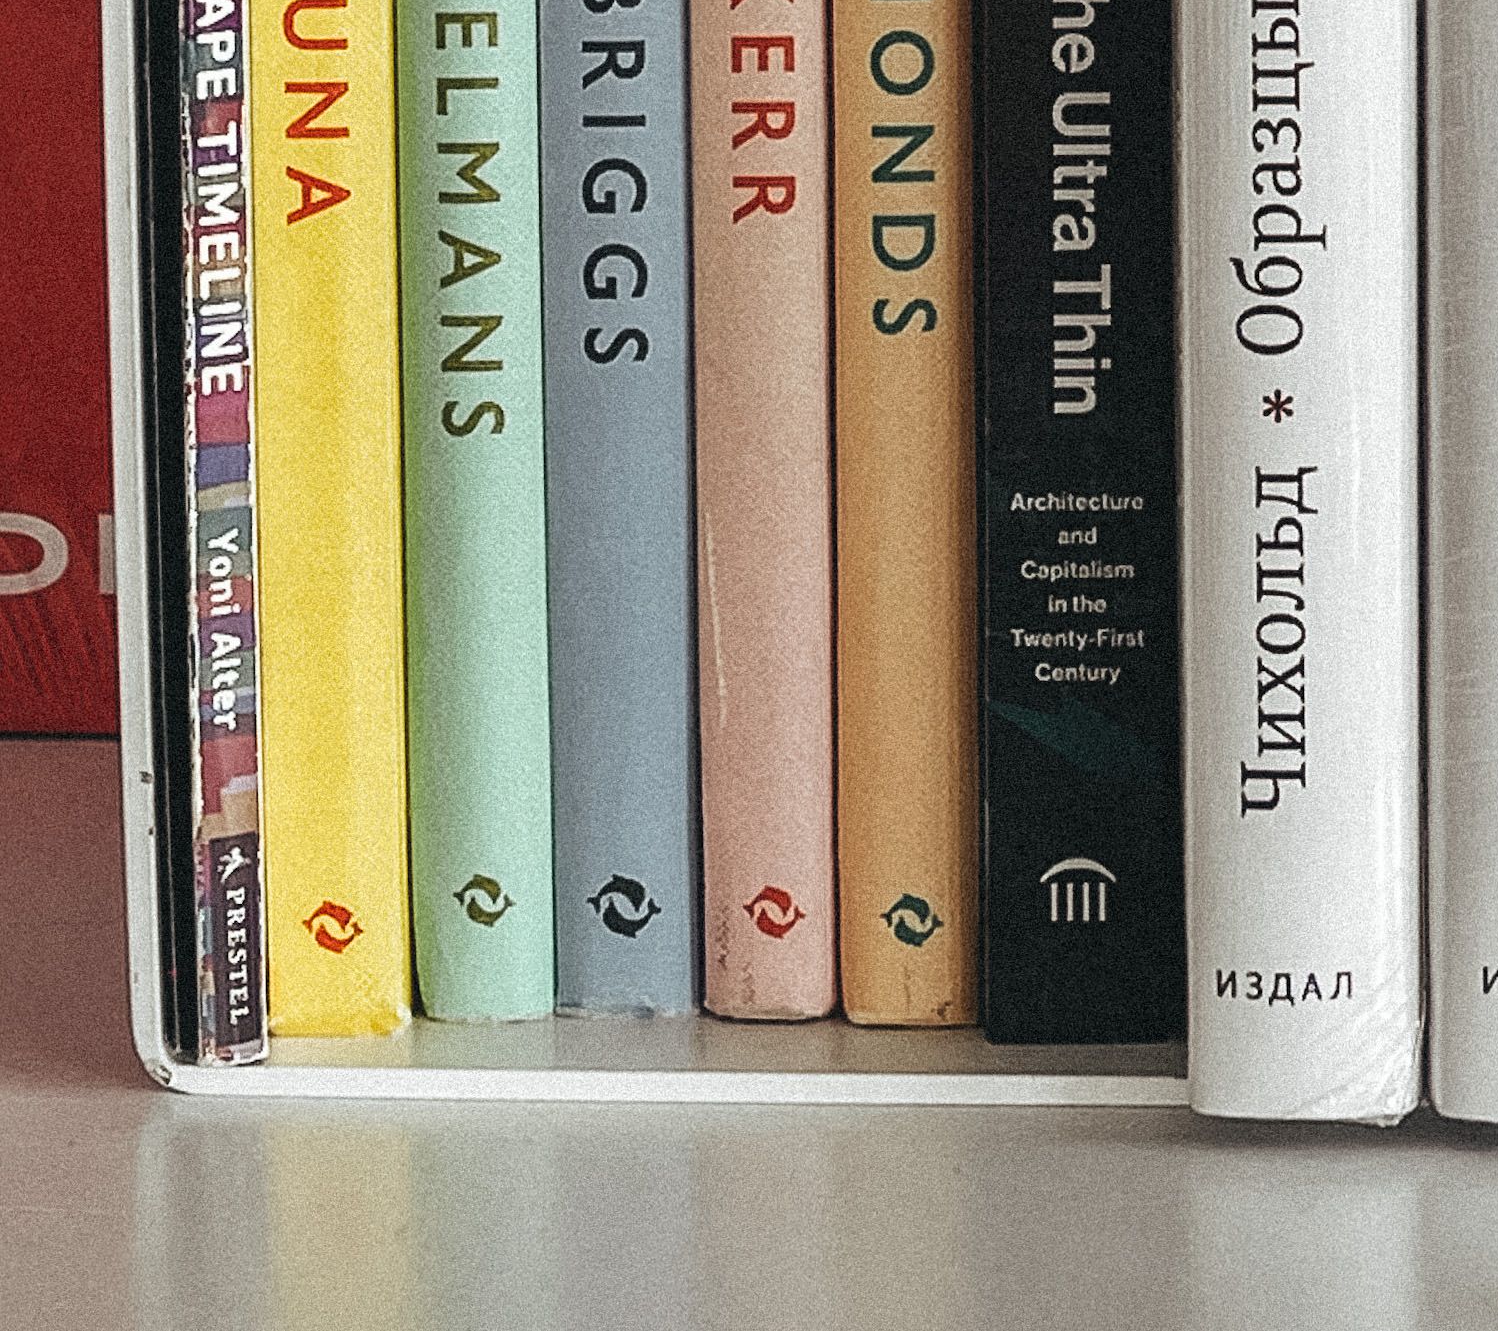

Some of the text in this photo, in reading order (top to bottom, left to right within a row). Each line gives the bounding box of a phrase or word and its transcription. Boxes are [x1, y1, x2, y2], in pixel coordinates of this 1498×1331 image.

[1051, 91, 1111, 252] Ultra
[195, 120, 243, 397] TIMELINE
[1052, 264, 1112, 416] Thin
[1010, 491, 1144, 512] Architecture
[1057, 525, 1097, 546] and
[1020, 559, 1136, 582] Capitalism
[1047, 594, 1107, 614] in the
[206, 527, 242, 733] Yoni Alter
[1011, 628, 1145, 651] Twenty-First
[1240, 465, 1319, 817] Чихольд
[1034, 663, 1121, 687] Century
[224, 887, 254, 1026] PRESTEL
[1215, 970, 1354, 1005] ИЗДАЛ
